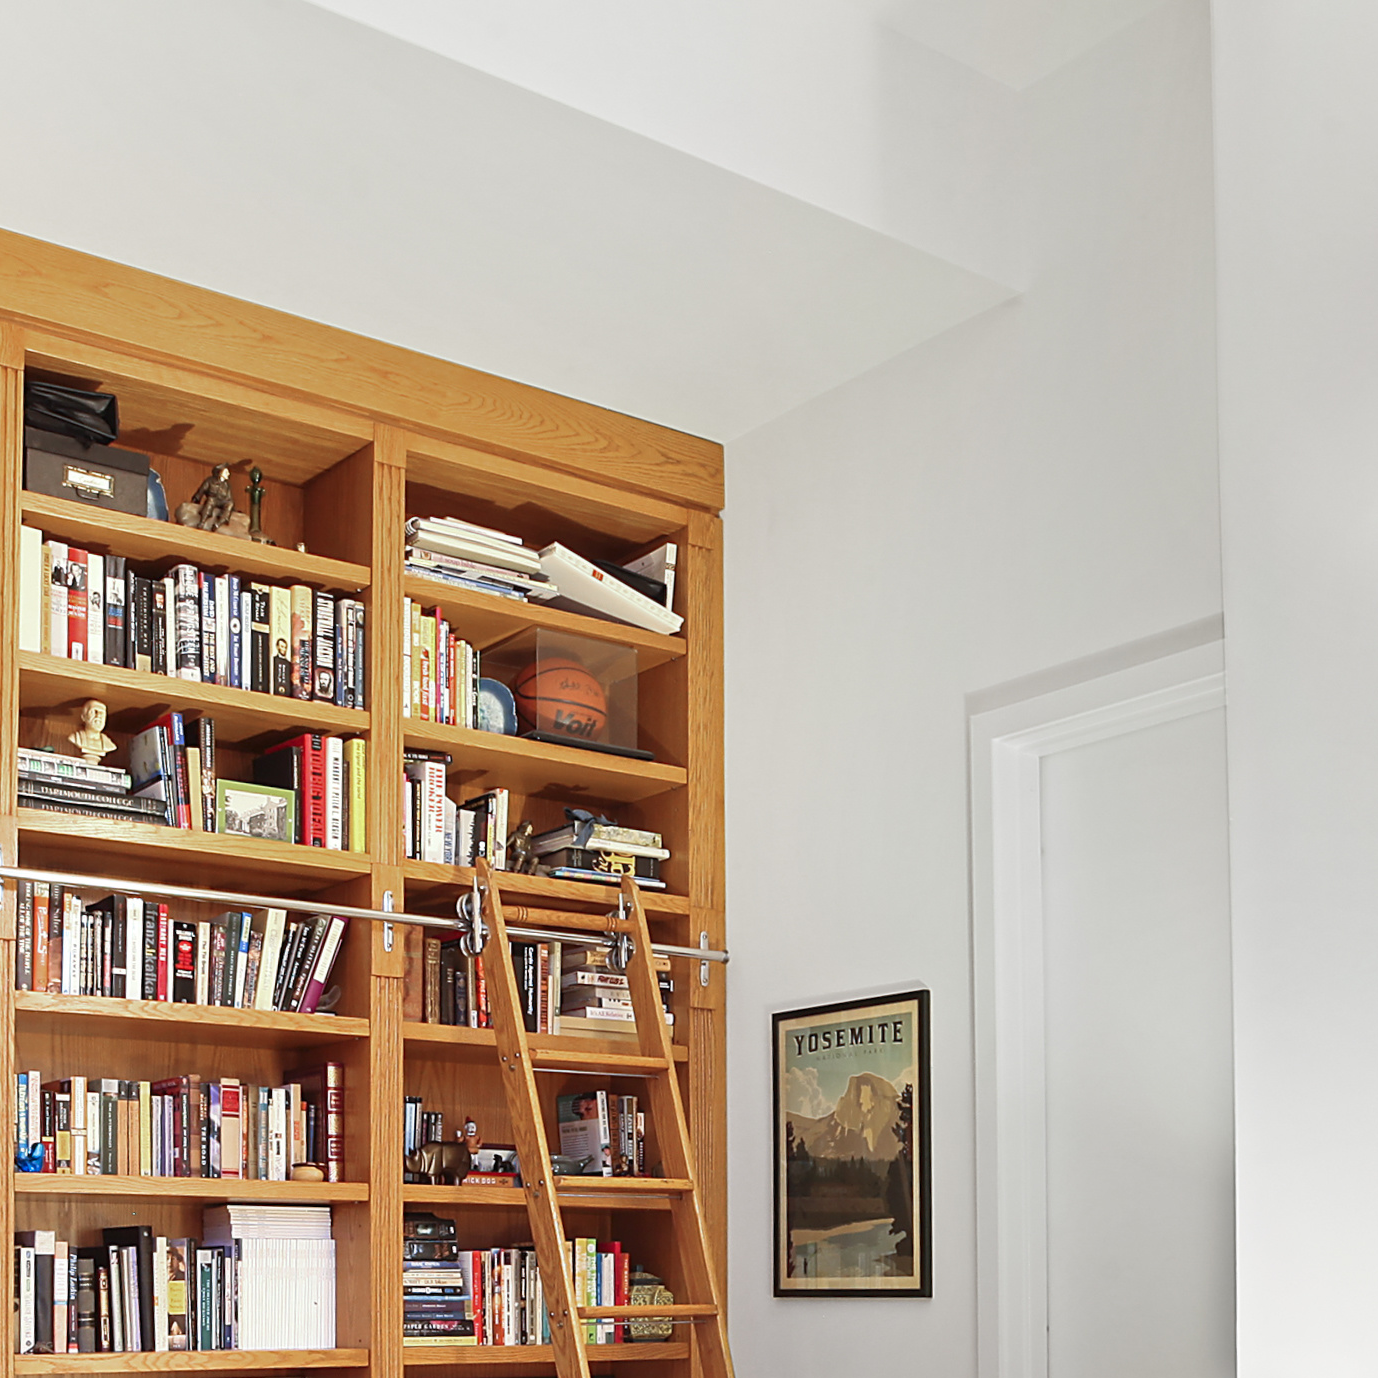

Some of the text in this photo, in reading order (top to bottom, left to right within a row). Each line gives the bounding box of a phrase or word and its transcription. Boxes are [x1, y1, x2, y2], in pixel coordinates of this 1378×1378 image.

[553, 708, 596, 737] Voit
[435, 794, 443, 832] POWER
[145, 911, 157, 993] franz kafka
[794, 1020, 903, 1056] YOSEMITE
[69, 1254, 77, 1300] Philip Larkin
